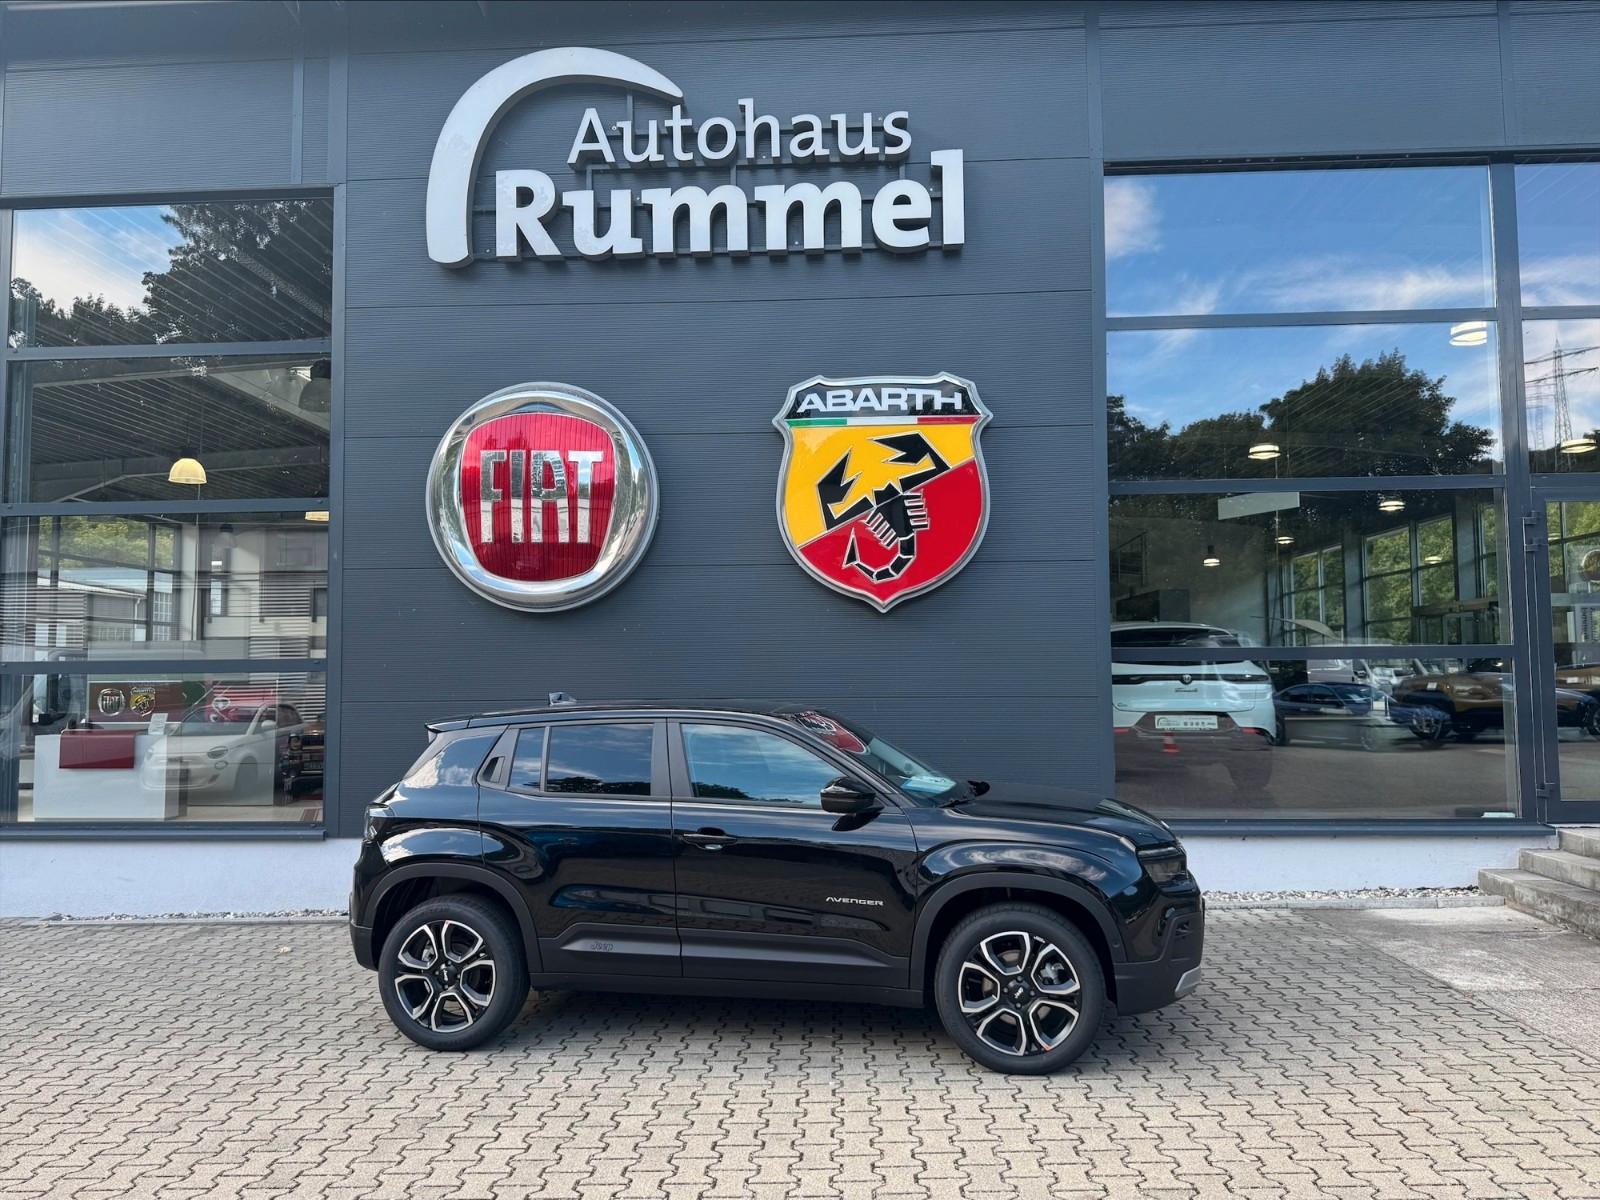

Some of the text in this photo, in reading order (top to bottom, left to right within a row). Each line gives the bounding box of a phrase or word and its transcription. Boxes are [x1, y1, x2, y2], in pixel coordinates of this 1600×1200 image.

[567, 97, 912, 165] Autohaus
[495, 148, 965, 258] Rummel
[796, 387, 963, 413] ABARTH
[479, 449, 604, 545] FIAT
[825, 896, 884, 906] AVENGER
